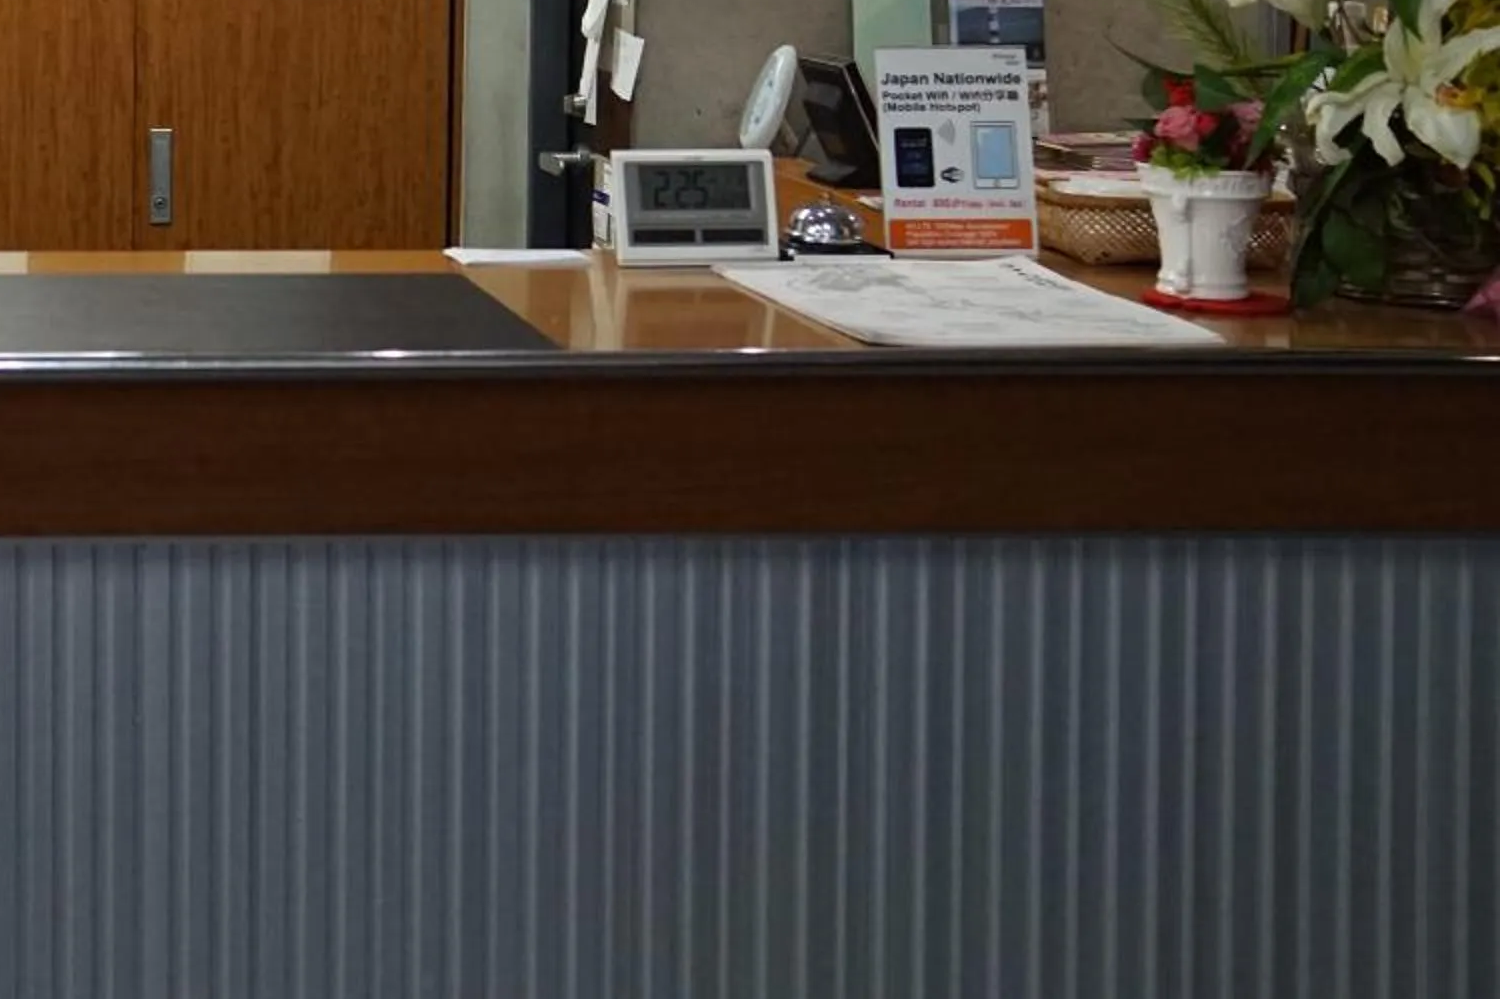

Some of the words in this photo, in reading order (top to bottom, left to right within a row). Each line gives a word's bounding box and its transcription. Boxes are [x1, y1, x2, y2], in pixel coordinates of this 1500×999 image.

[881, 73, 929, 87] Japan
[933, 72, 1021, 86] Nationwide
[882, 90, 923, 101] Pocket
[883, 103, 927, 114] (Mobile
